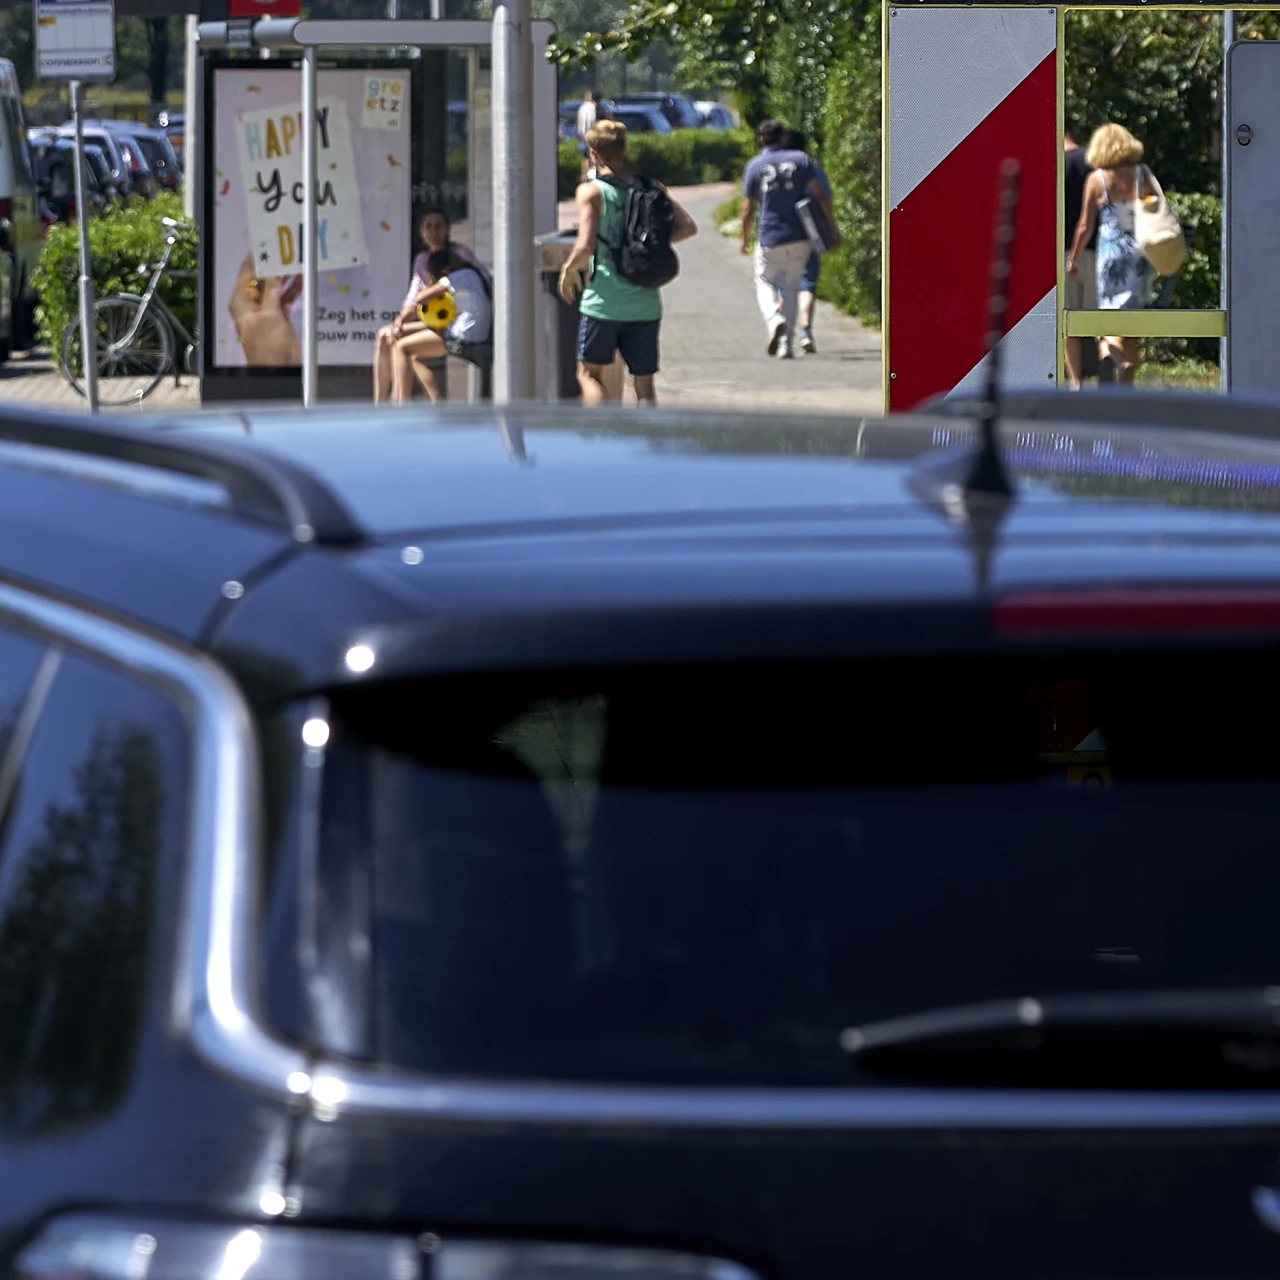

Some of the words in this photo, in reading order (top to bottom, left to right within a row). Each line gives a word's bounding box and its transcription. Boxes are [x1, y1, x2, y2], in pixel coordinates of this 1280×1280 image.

[318, 307, 347, 324] Zeg
[351, 308, 377, 321] het
[317, 331, 349, 341] ouw
[352, 331, 376, 341] ma
